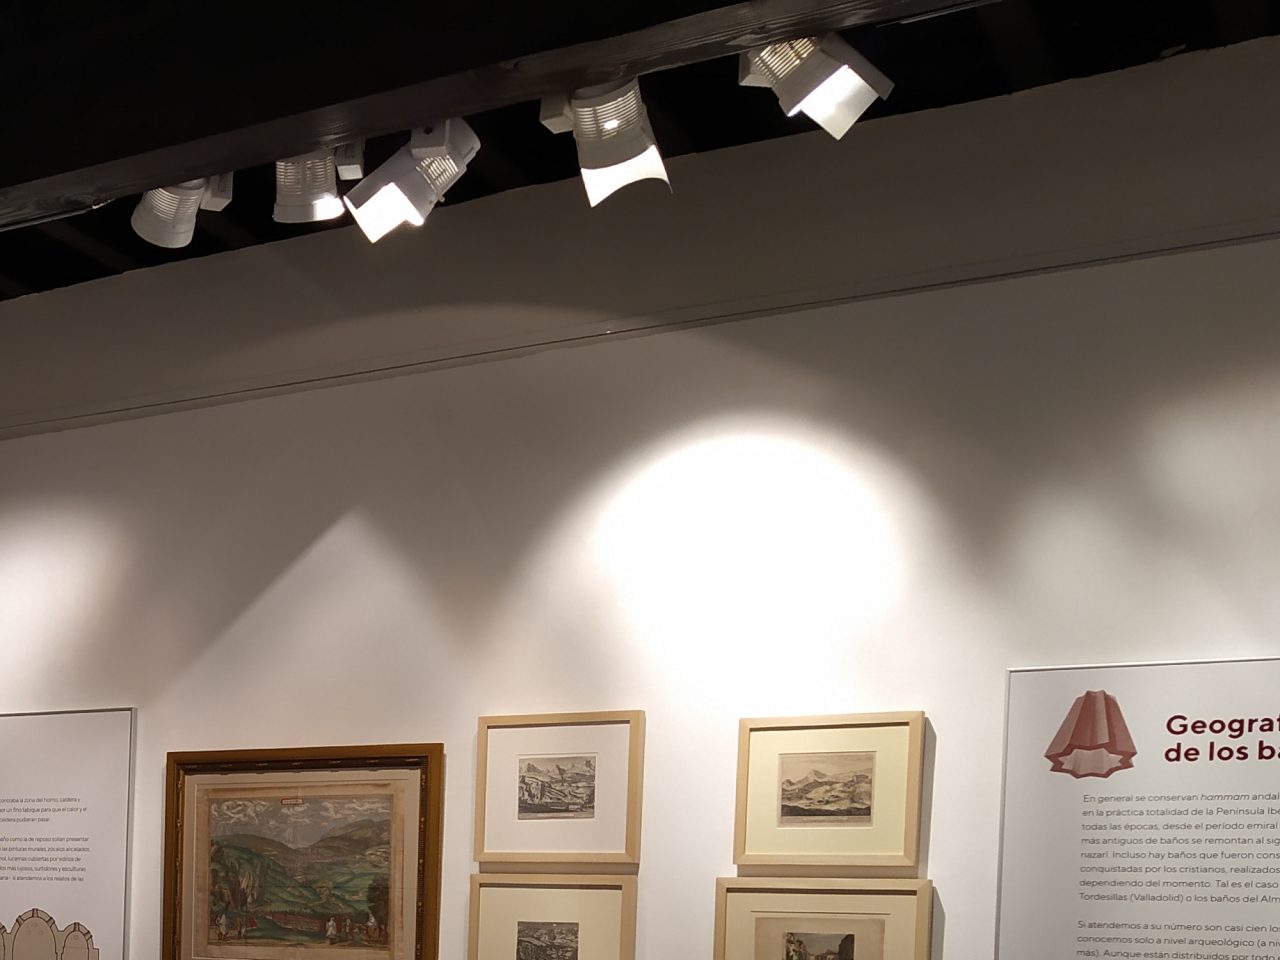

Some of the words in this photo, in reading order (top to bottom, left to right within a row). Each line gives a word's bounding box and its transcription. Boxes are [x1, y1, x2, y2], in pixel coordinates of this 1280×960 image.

[1164, 742, 1200, 762] de
[1208, 741, 1249, 761] los
[1258, 740, 1280, 760] b
[1097, 793, 1133, 804] general
[1201, 792, 1250, 801] hammam
[1252, 792, 1280, 801] andal
[1106, 808, 1145, 818] práctica
[1146, 807, 1189, 816] totalidad
[1081, 822, 1108, 830] todas
[1162, 822, 1193, 830] desde
[1246, 822, 1278, 830] emiral
[1102, 836, 1143, 847] antiguos
[1160, 836, 1189, 845] baños
[1204, 836, 1254, 845] remontan
[1113, 850, 1147, 859] Incluso
[1168, 850, 1197, 859] baños
[1221, 851, 1254, 859] fueron
[1080, 864, 1142, 875] conquistadas
[1230, 865, 1280, 874] realizados
[1080, 879, 1143, 889] dependiendo
[1130, 893, 1183, 904] (Valladolid)
[1210, 894, 1241, 902] baños
[1087, 921, 1141, 930] atendemos
[1224, 923, 1243, 932] casi
[1246, 923, 1267, 932] cien
[1076, 936, 1133, 944] conocemos
[1164, 936, 1186, 945] nivel
[1189, 937, 1255, 949] arqueológico
[1103, 949, 1141, 960] Aunque
[1143, 950, 1170, 959] están
